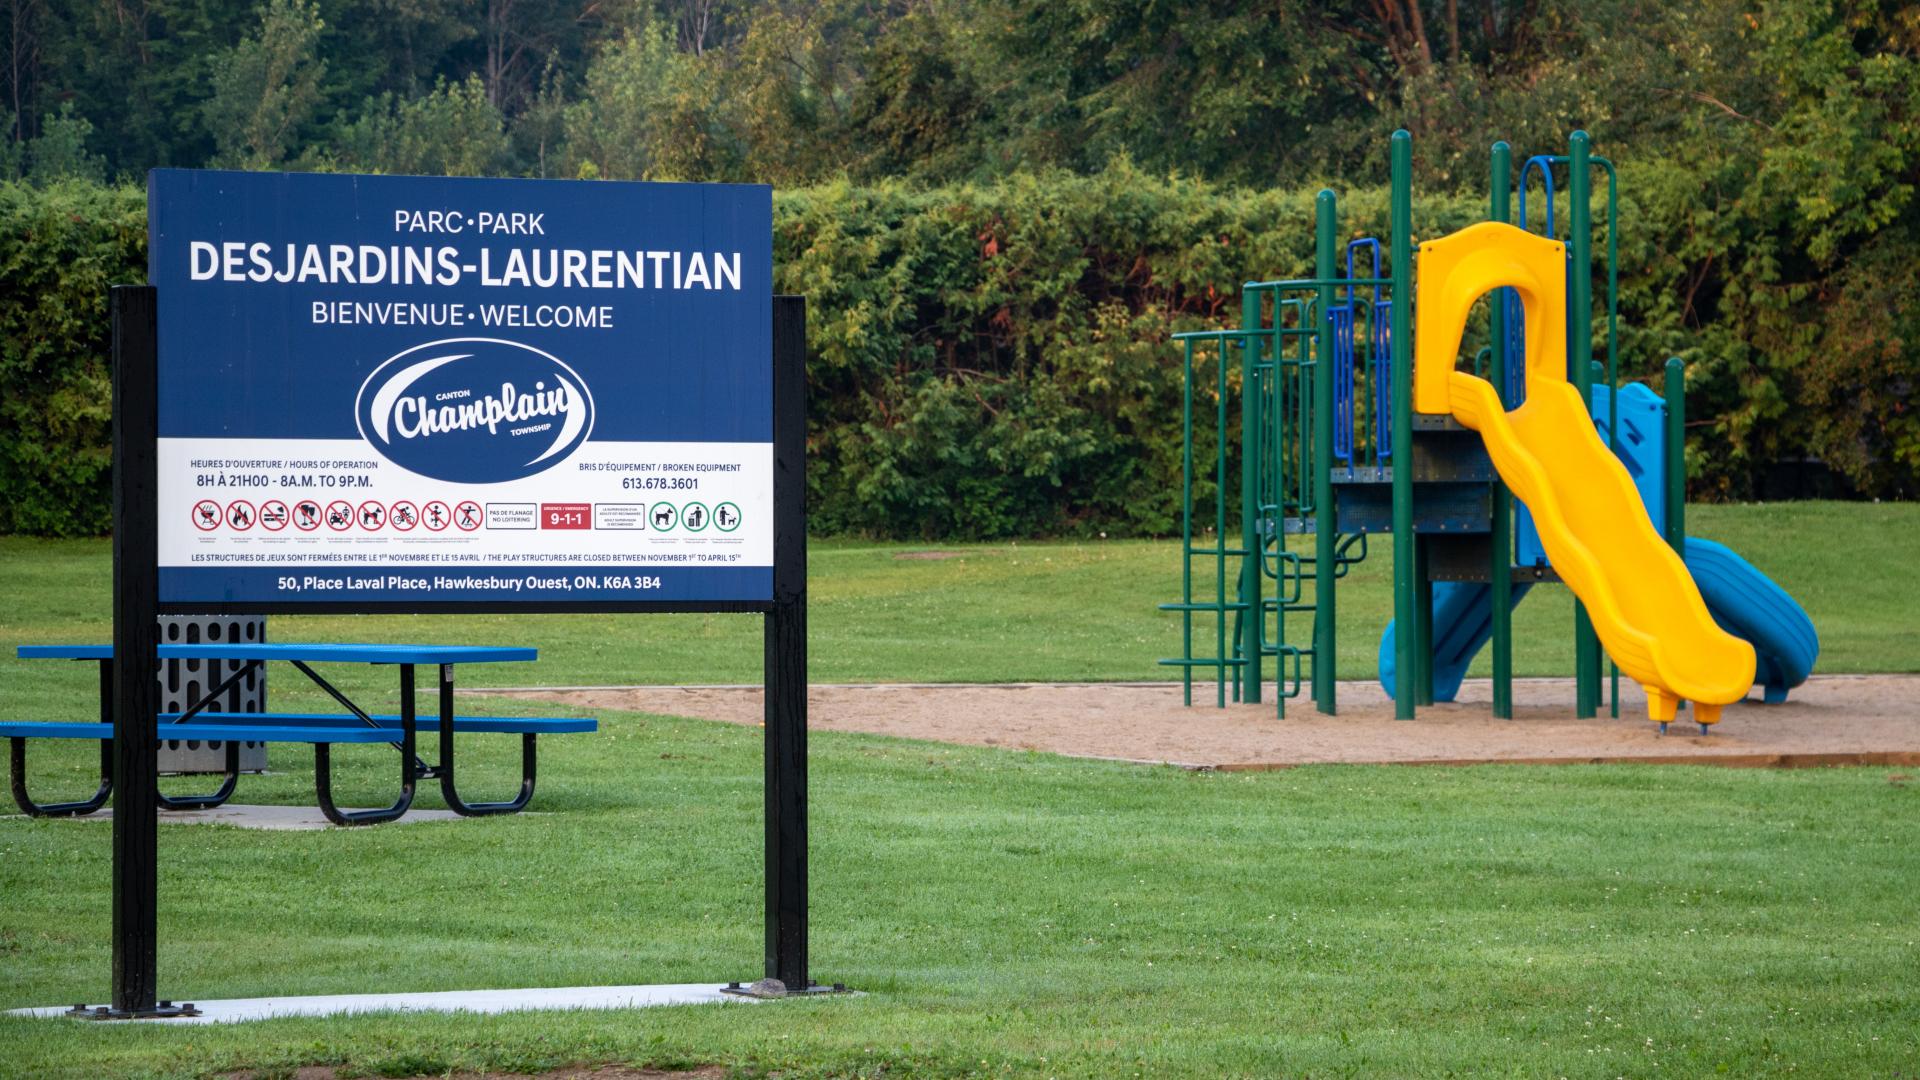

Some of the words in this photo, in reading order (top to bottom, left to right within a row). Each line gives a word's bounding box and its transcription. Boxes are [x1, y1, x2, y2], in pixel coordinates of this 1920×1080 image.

[190, 241, 742, 291] DESJARDINS-LAURENTIAN
[435, 389, 471, 402] CANTON
[394, 381, 569, 439] Champlain
[510, 423, 552, 437] TOWNSHIP
[190, 460, 224, 469] HEURES
[225, 460, 282, 469] D'OUVERTURE
[289, 460, 318, 469] HOURS
[319, 460, 331, 469] OF
[332, 460, 379, 470] OPERATION
[579, 463, 597, 471] BRIS
[598, 461, 657, 472] D'ÉQUIPEMENT
[662, 463, 695, 472] BROKEN
[695, 463, 742, 472] EQUIPMENT
[196, 474, 215, 487] 8H
[217, 471, 227, 487] À
[229, 474, 269, 487] 21H00
[280, 474, 317, 488] 8A.M.
[318, 475, 336, 488] TO
[338, 475, 373, 488] 9P.M.
[622, 477, 699, 490] 613.678.3601
[550, 512, 582, 526] 9-1-1
[191, 554, 204, 562] LES
[206, 554, 254, 562] STRUCTURES
[255, 554, 265, 562] DE
[266, 554, 286, 562] JEUX
[287, 554, 307, 562] SONT
[308, 552, 342, 562] FERMÉES
[343, 554, 368, 562] ENTRE
[369, 554, 378, 562] LE
[388, 554, 430, 562] NOVEMBRE
[431, 554, 441, 562] ET
[441, 554, 450, 562] LE
[451, 554, 458, 562] 15
[459, 554, 480, 562] AVRIL
[488, 554, 502, 562] THE
[503, 554, 521, 562] PLAY
[521, 554, 567, 562] STRUCTURES
[568, 554, 582, 562] ARE
[583, 554, 612, 562] CLOSED
[612, 554, 647, 562] BETWEEN
[648, 554, 688, 562] NOVEMBER
[697, 554, 707, 562] TO
[707, 554, 728, 562] APRIL
[277, 577, 301, 592] 50,
[303, 576, 344, 590] Place
[346, 576, 385, 590] Laval
[388, 576, 432, 592] Place,
[434, 576, 524, 593] Hawkesbury
[525, 576, 572, 592] Ouest,
[574, 576, 601, 590] ON.
[603, 576, 632, 590] K6A
[633, 576, 662, 590] 3B4
